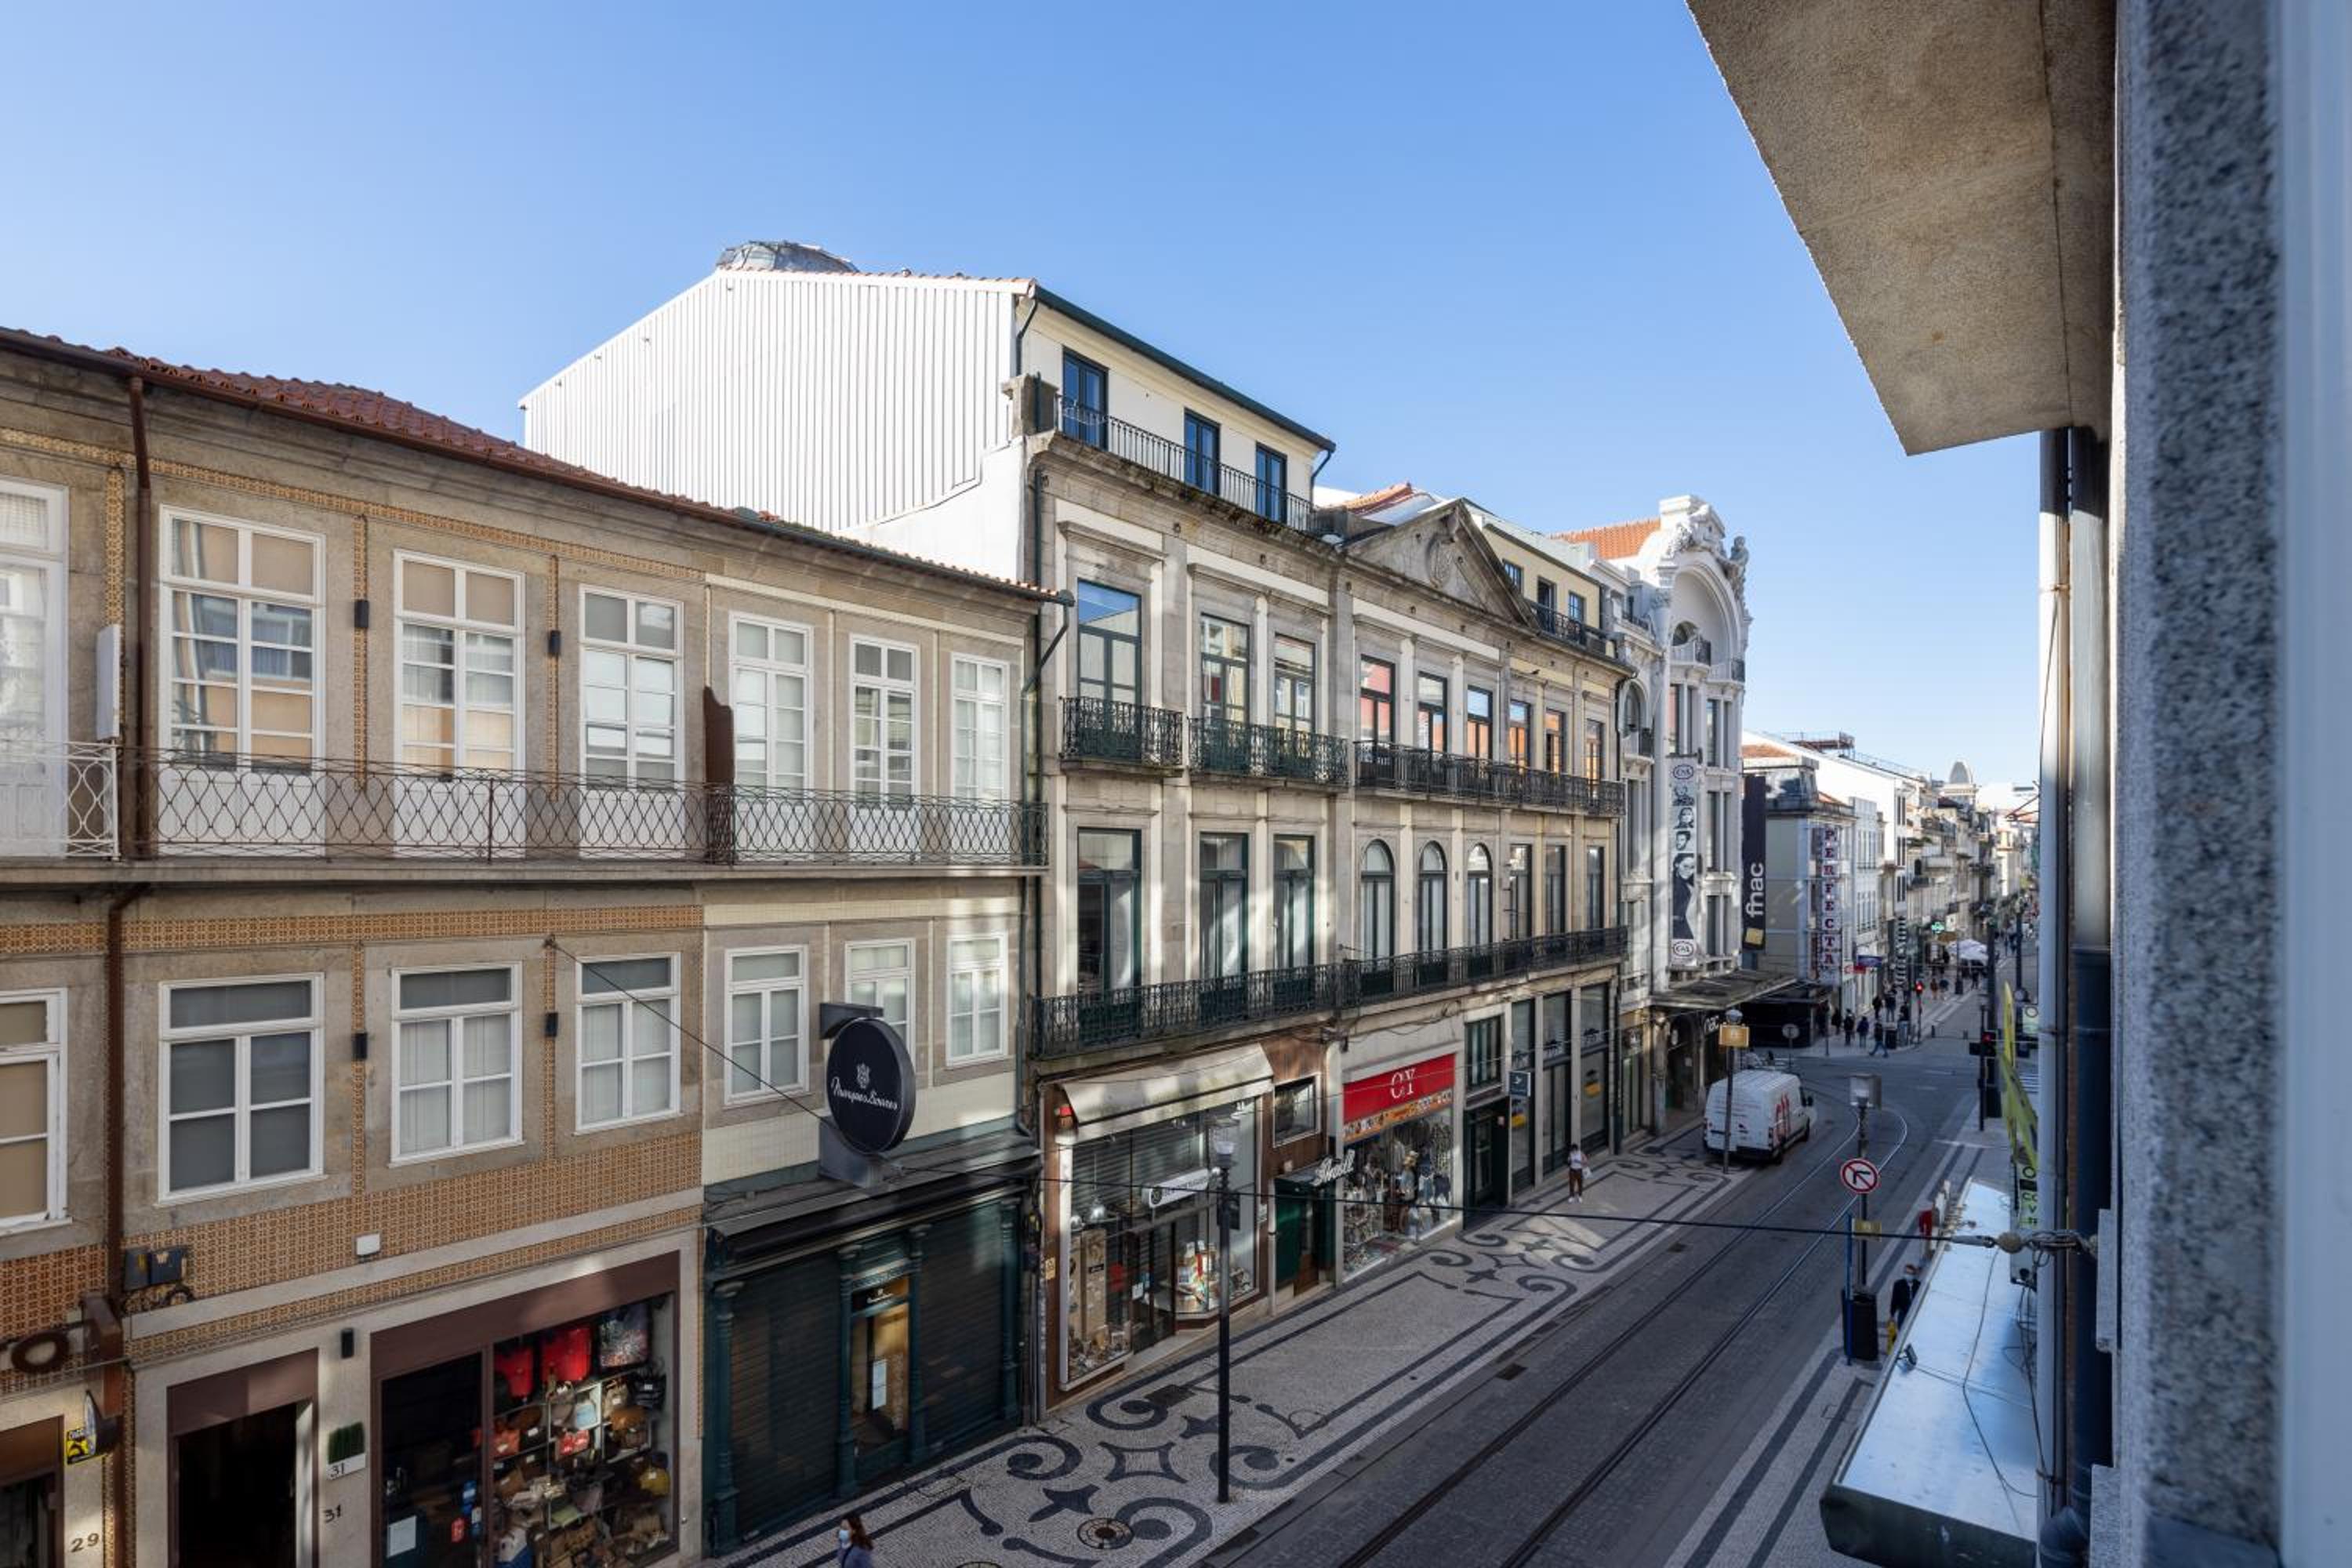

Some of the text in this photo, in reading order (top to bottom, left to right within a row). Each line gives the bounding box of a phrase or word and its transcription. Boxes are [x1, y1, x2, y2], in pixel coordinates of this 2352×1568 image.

[1745, 862, 1764, 918] fnac
[1824, 829, 1835, 965] PERFECTA
[330, 1462, 345, 1478] 31
[324, 1504, 342, 1523] 31
[69, 1531, 100, 1554] 29
